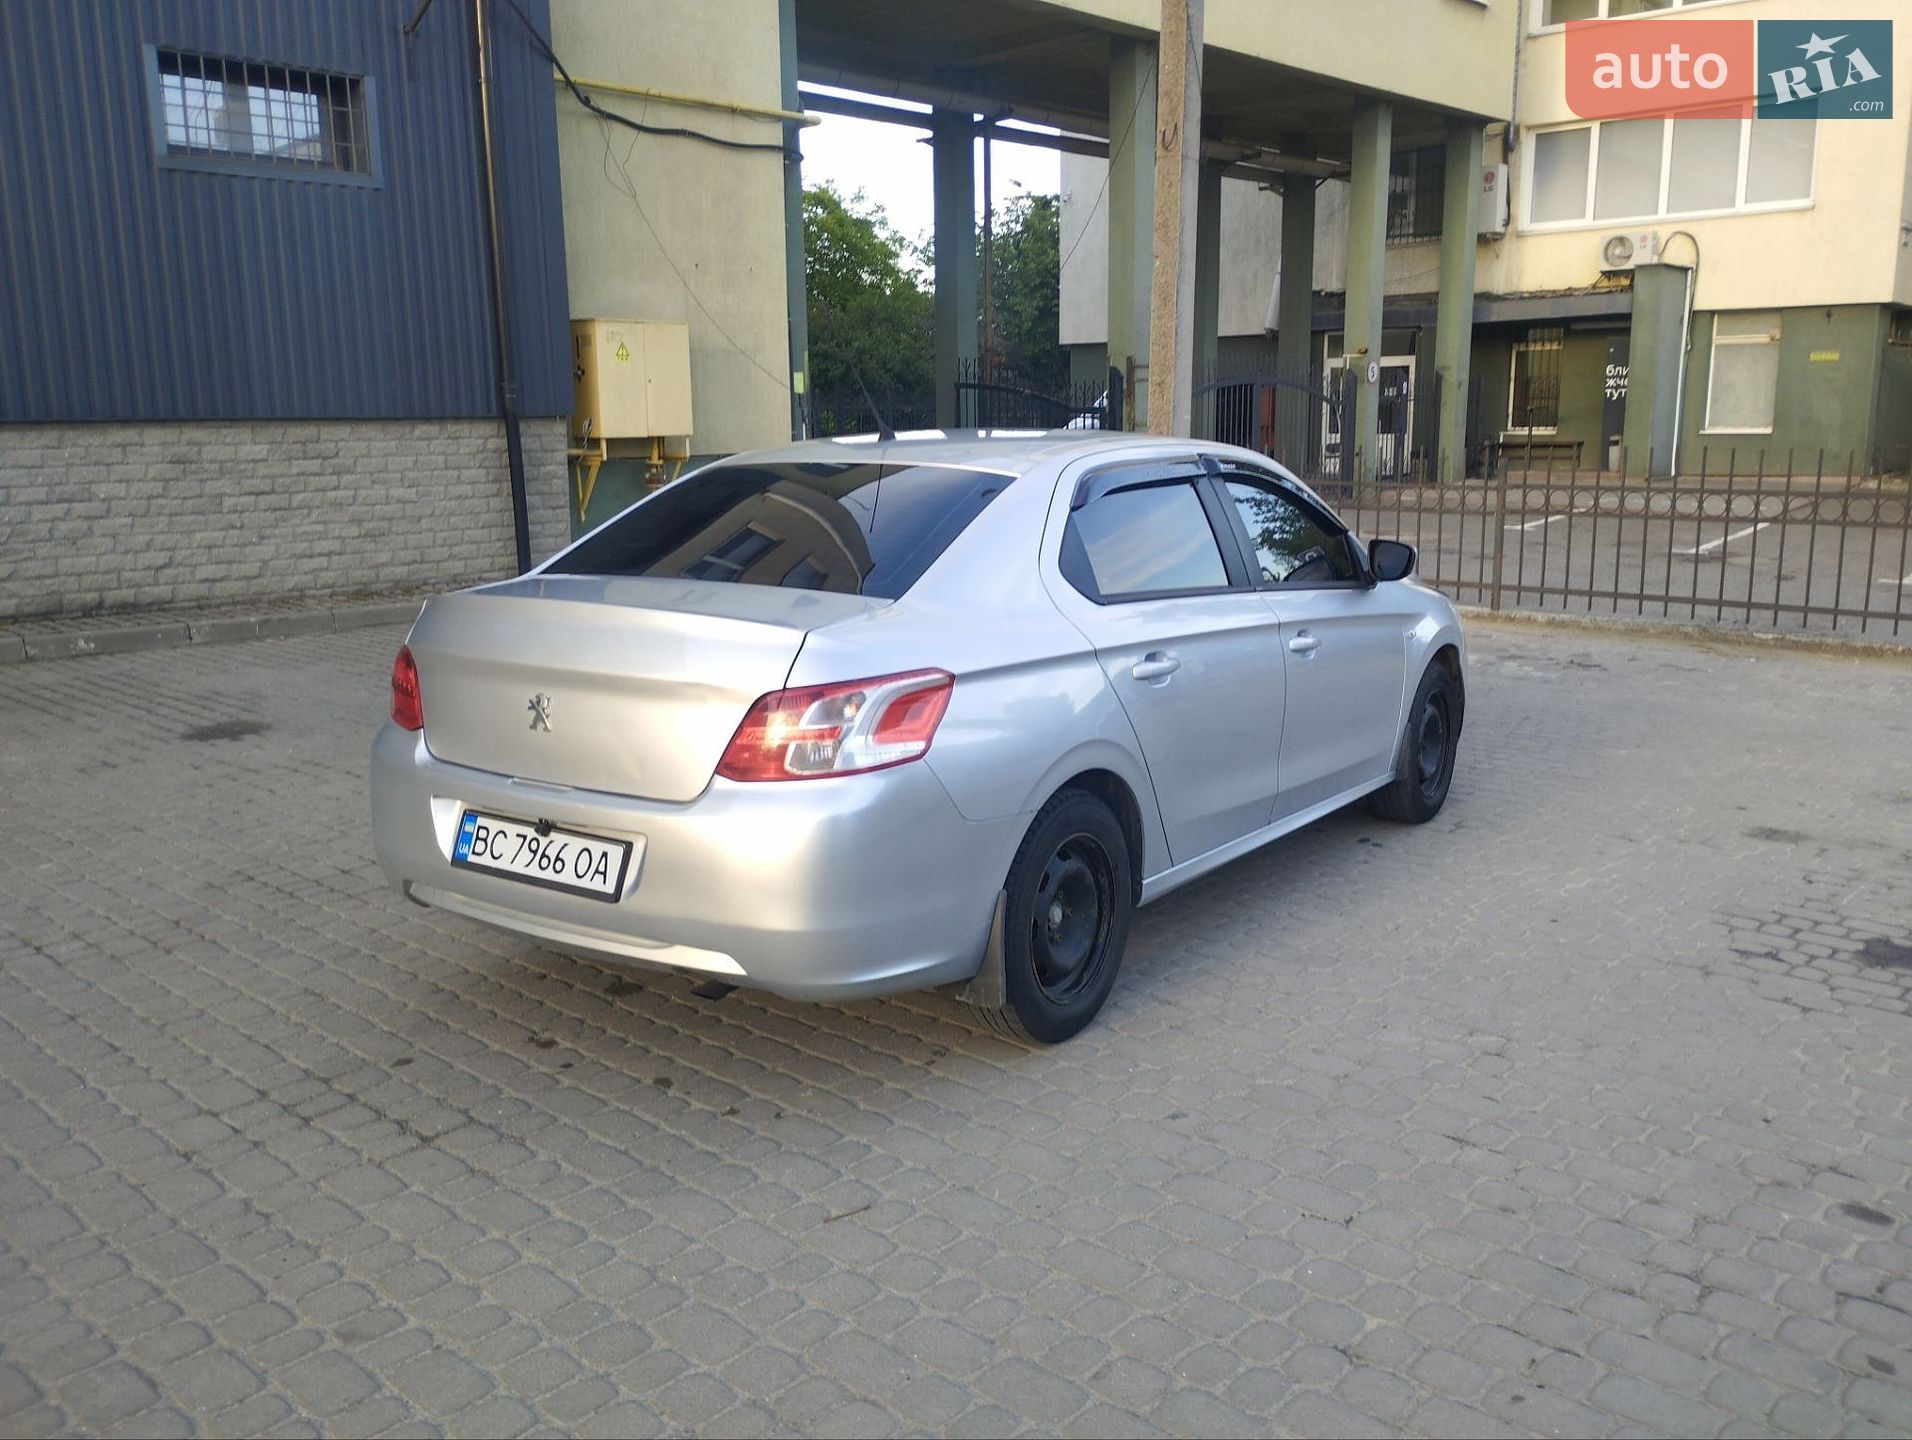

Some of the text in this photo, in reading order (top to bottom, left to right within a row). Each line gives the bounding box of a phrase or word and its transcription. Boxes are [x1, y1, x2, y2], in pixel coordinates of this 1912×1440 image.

[1605, 388, 1628, 401] тут
[458, 842, 470, 855] UA
[471, 824, 609, 885] BC 7966 OA
